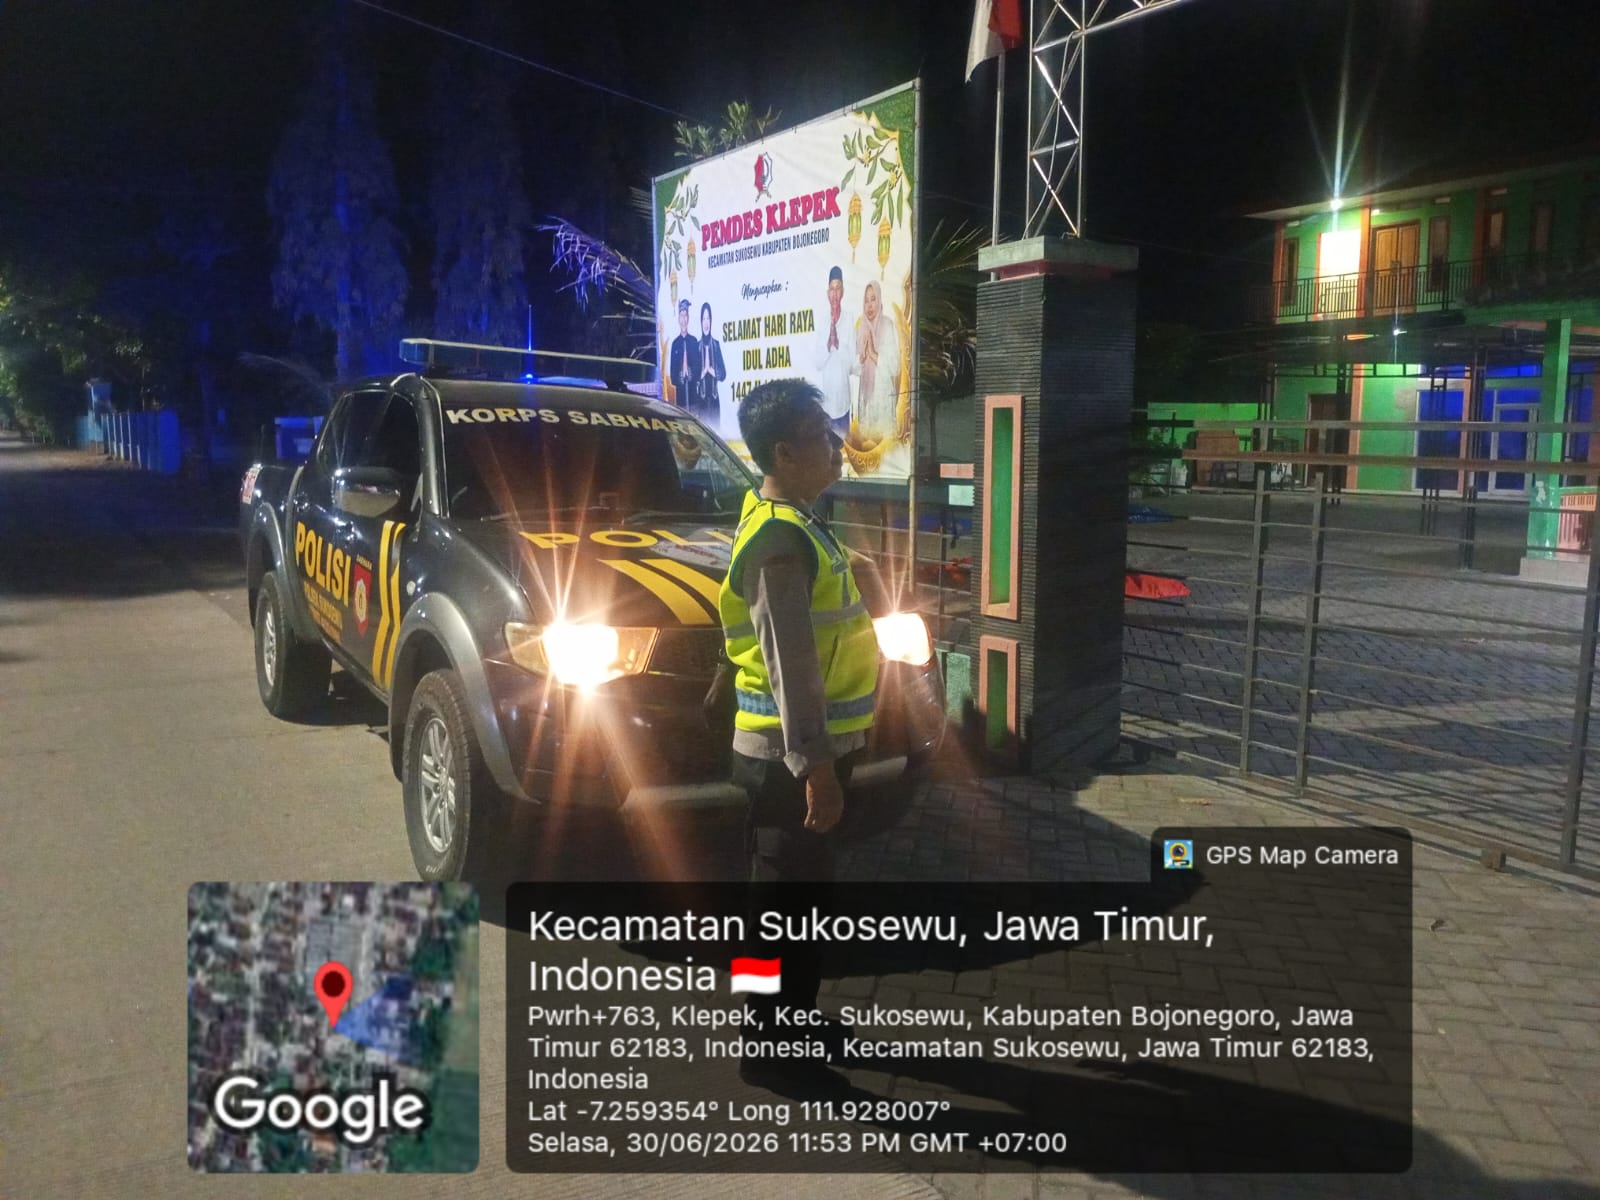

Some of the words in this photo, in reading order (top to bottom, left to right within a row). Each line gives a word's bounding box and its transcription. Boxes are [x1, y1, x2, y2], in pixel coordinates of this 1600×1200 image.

[701, 208, 763, 251] PEMDES
[766, 186, 841, 233] KLEPEK
[708, 251, 735, 269] KECAMATAN
[735, 243, 761, 263] SUKOSEWU
[762, 236, 791, 256] KABUPATEN
[792, 227, 830, 250] BOJONEGORO
[722, 316, 761, 342] SELAMAT
[764, 312, 787, 336] HARI
[789, 309, 815, 333] RAYA
[742, 348, 763, 371] IDUL
[765, 345, 792, 369] ADHA
[446, 408, 560, 424] KORPS
[567, 410, 701, 435] SABHARA
[519, 529, 734, 549] POLI
[295, 521, 352, 608] POLISI
